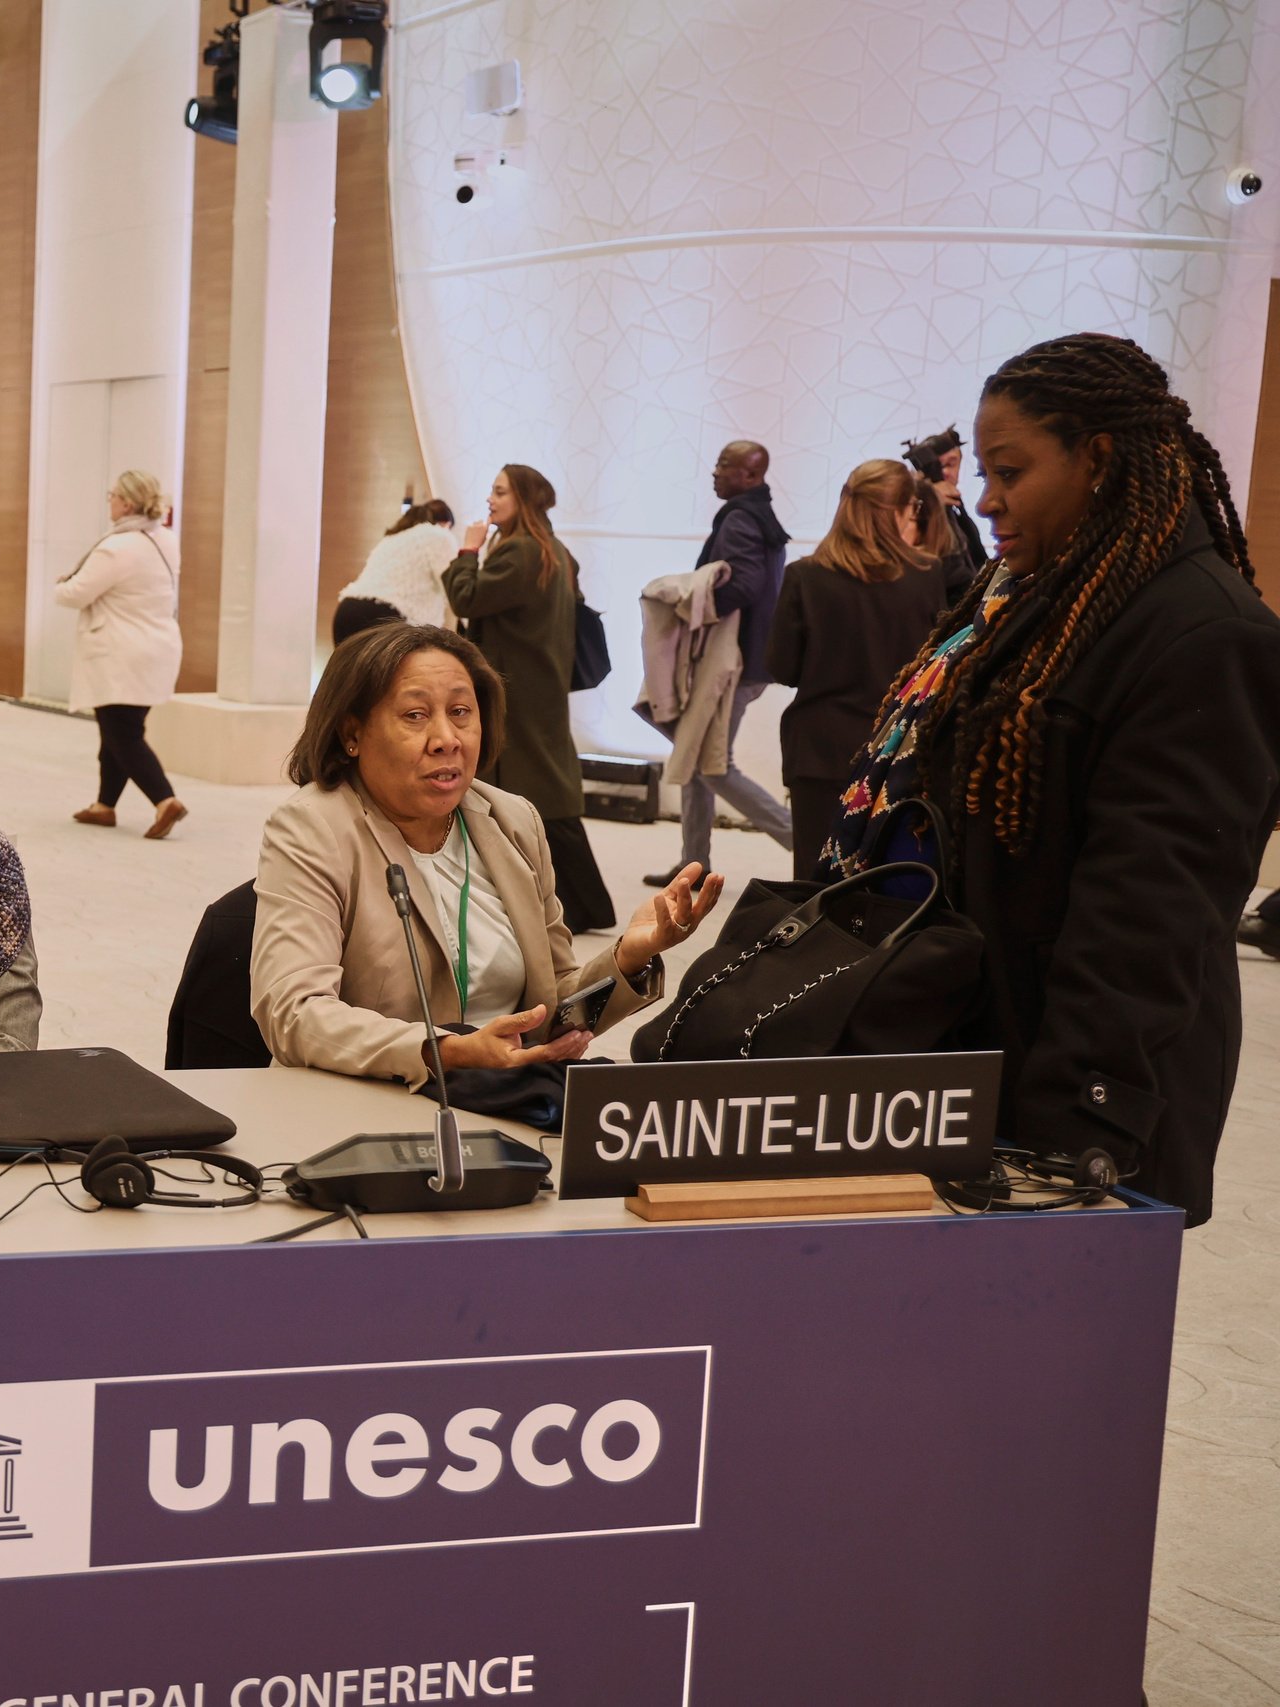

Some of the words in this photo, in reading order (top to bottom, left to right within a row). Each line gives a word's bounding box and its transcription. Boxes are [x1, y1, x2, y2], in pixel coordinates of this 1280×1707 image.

[417, 1145, 473, 1158] BOH
[596, 1089, 972, 1161] SAINTE-LUCIE
[149, 1399, 661, 1511] unesco
[231, 1655, 534, 1707] CONFERENCE
